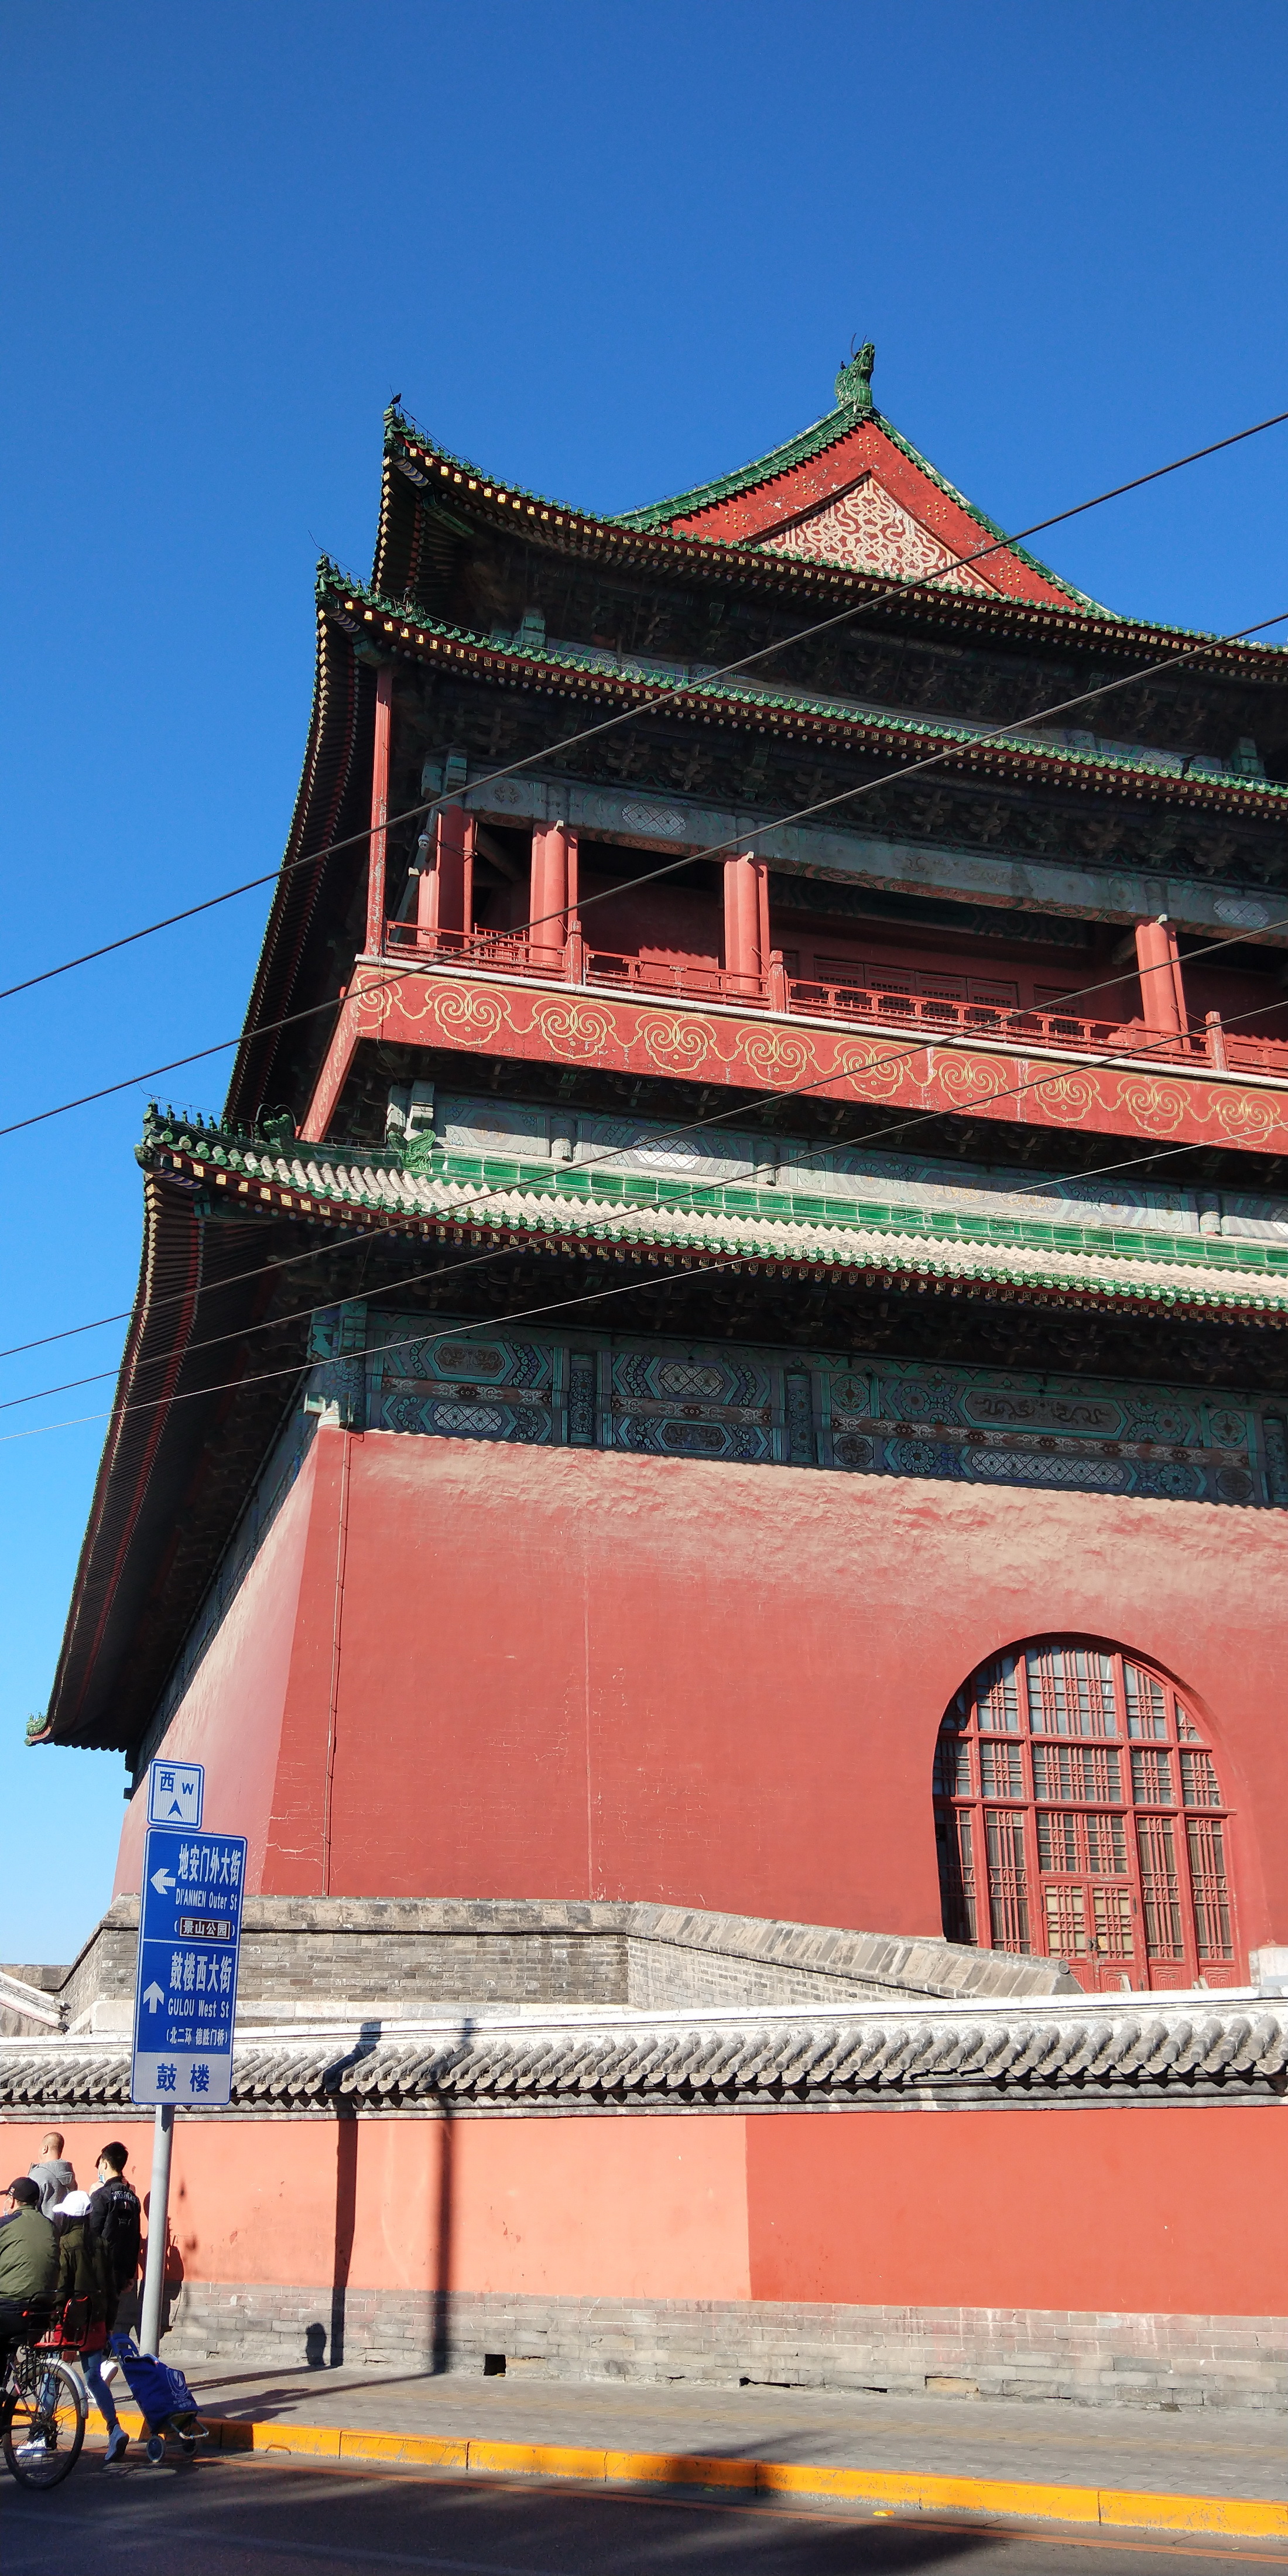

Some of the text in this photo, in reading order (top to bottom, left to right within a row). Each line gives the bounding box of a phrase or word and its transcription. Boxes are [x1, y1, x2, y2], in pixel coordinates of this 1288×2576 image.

[160, 1770, 176, 1793] 西
[181, 1782, 194, 1795] W
[177, 1843, 241, 1886] 地安门外大街
[175, 1888, 238, 1911] DI'ANMEN Outer St
[169, 1951, 232, 1993] 鼓楼西大街
[168, 1998, 229, 2018] GULOU West St
